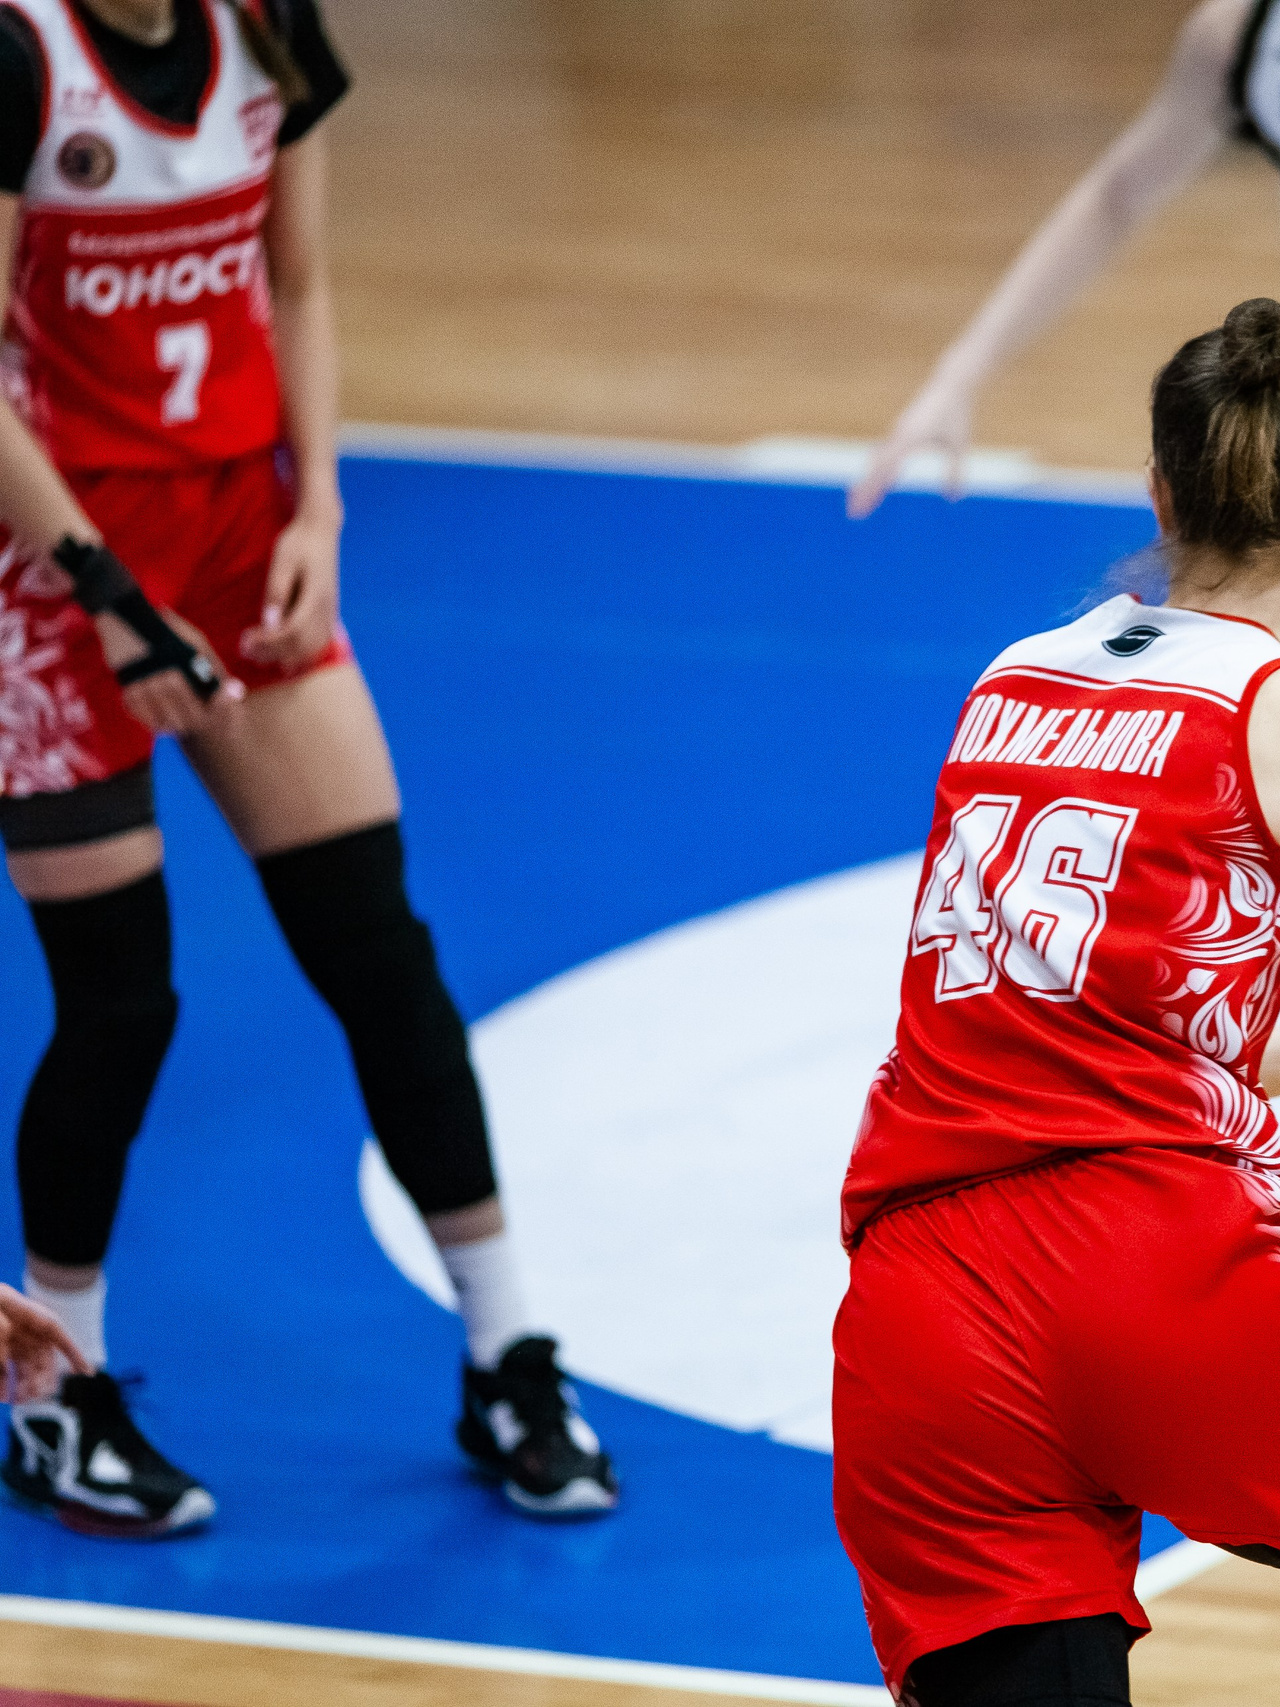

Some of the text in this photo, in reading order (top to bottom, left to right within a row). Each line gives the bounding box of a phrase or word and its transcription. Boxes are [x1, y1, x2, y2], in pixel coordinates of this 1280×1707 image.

[64, 236, 258, 318] ЮНОСТ
[154, 318, 213, 427] 7
[911, 792, 1140, 1004] 46
